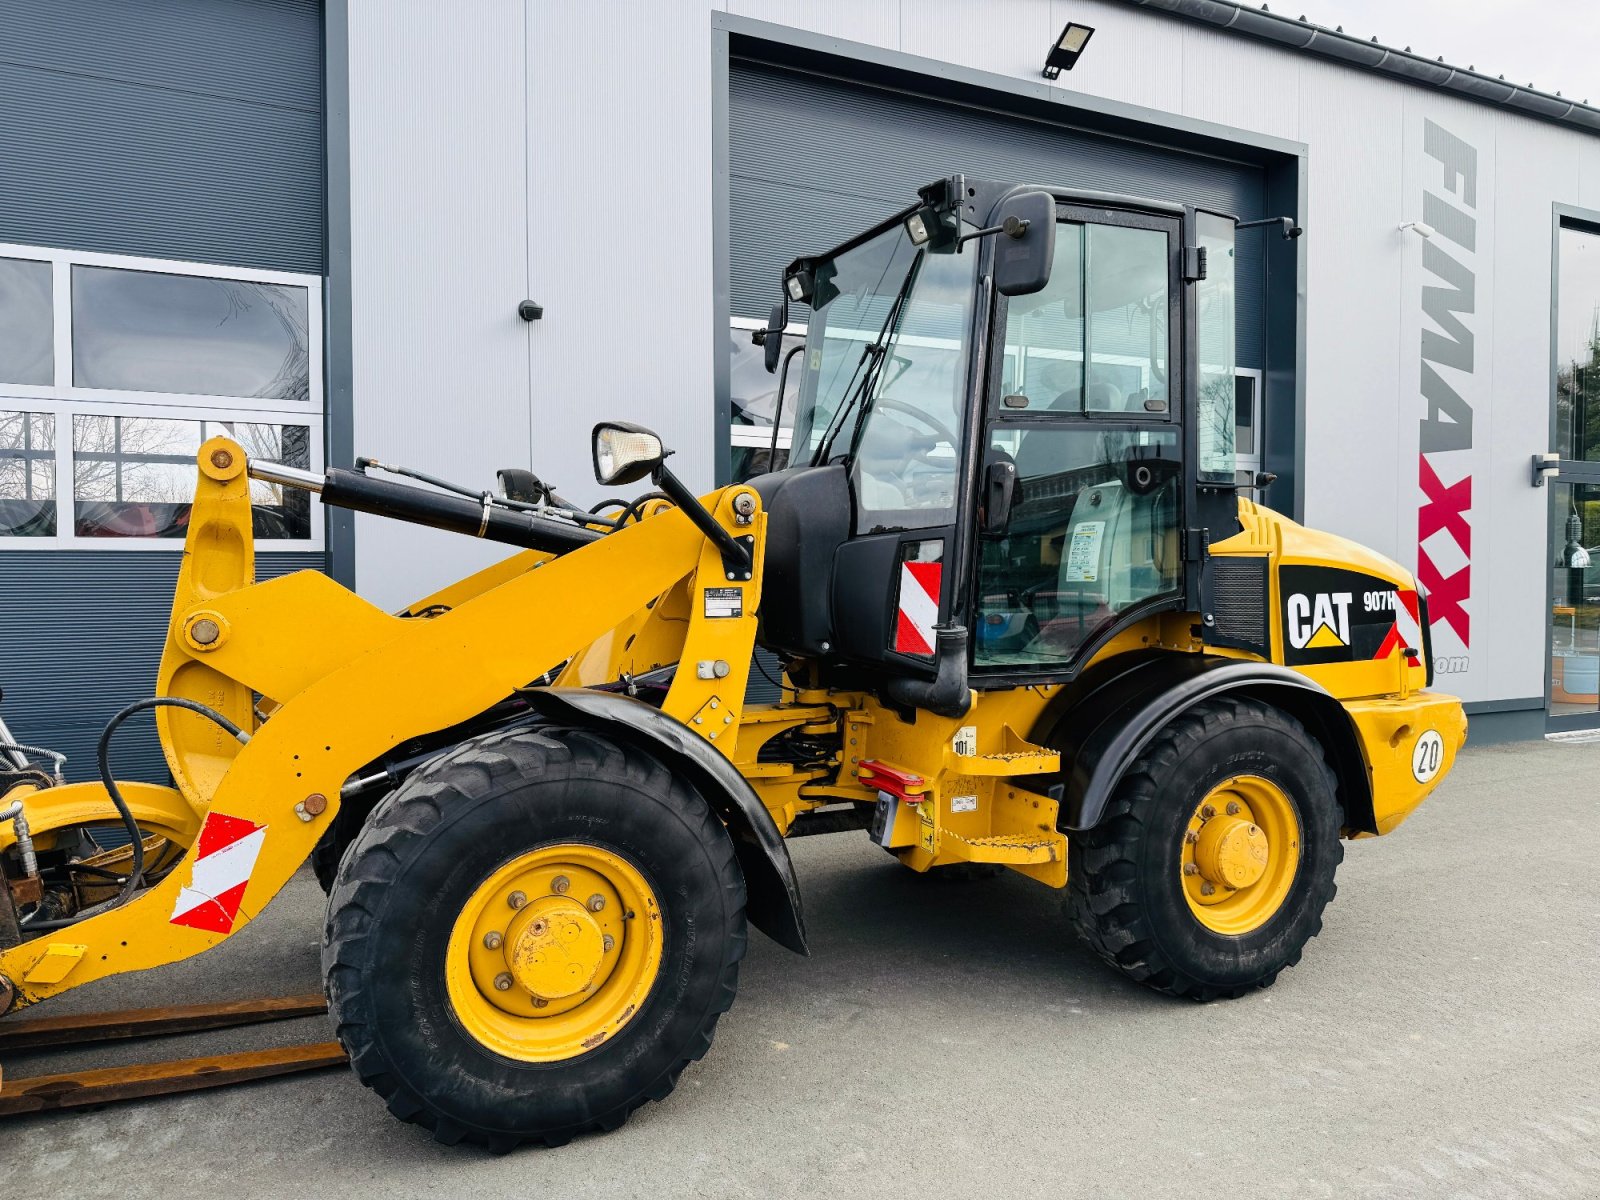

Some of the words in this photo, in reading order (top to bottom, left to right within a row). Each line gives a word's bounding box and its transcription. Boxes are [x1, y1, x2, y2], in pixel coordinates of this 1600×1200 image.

[1418, 117, 1478, 649] FIMAXX
[1287, 592, 1353, 649] CAT
[1363, 590, 1396, 612] 907H
[1433, 656, 1469, 674] om
[1418, 740, 1439, 773] 20
